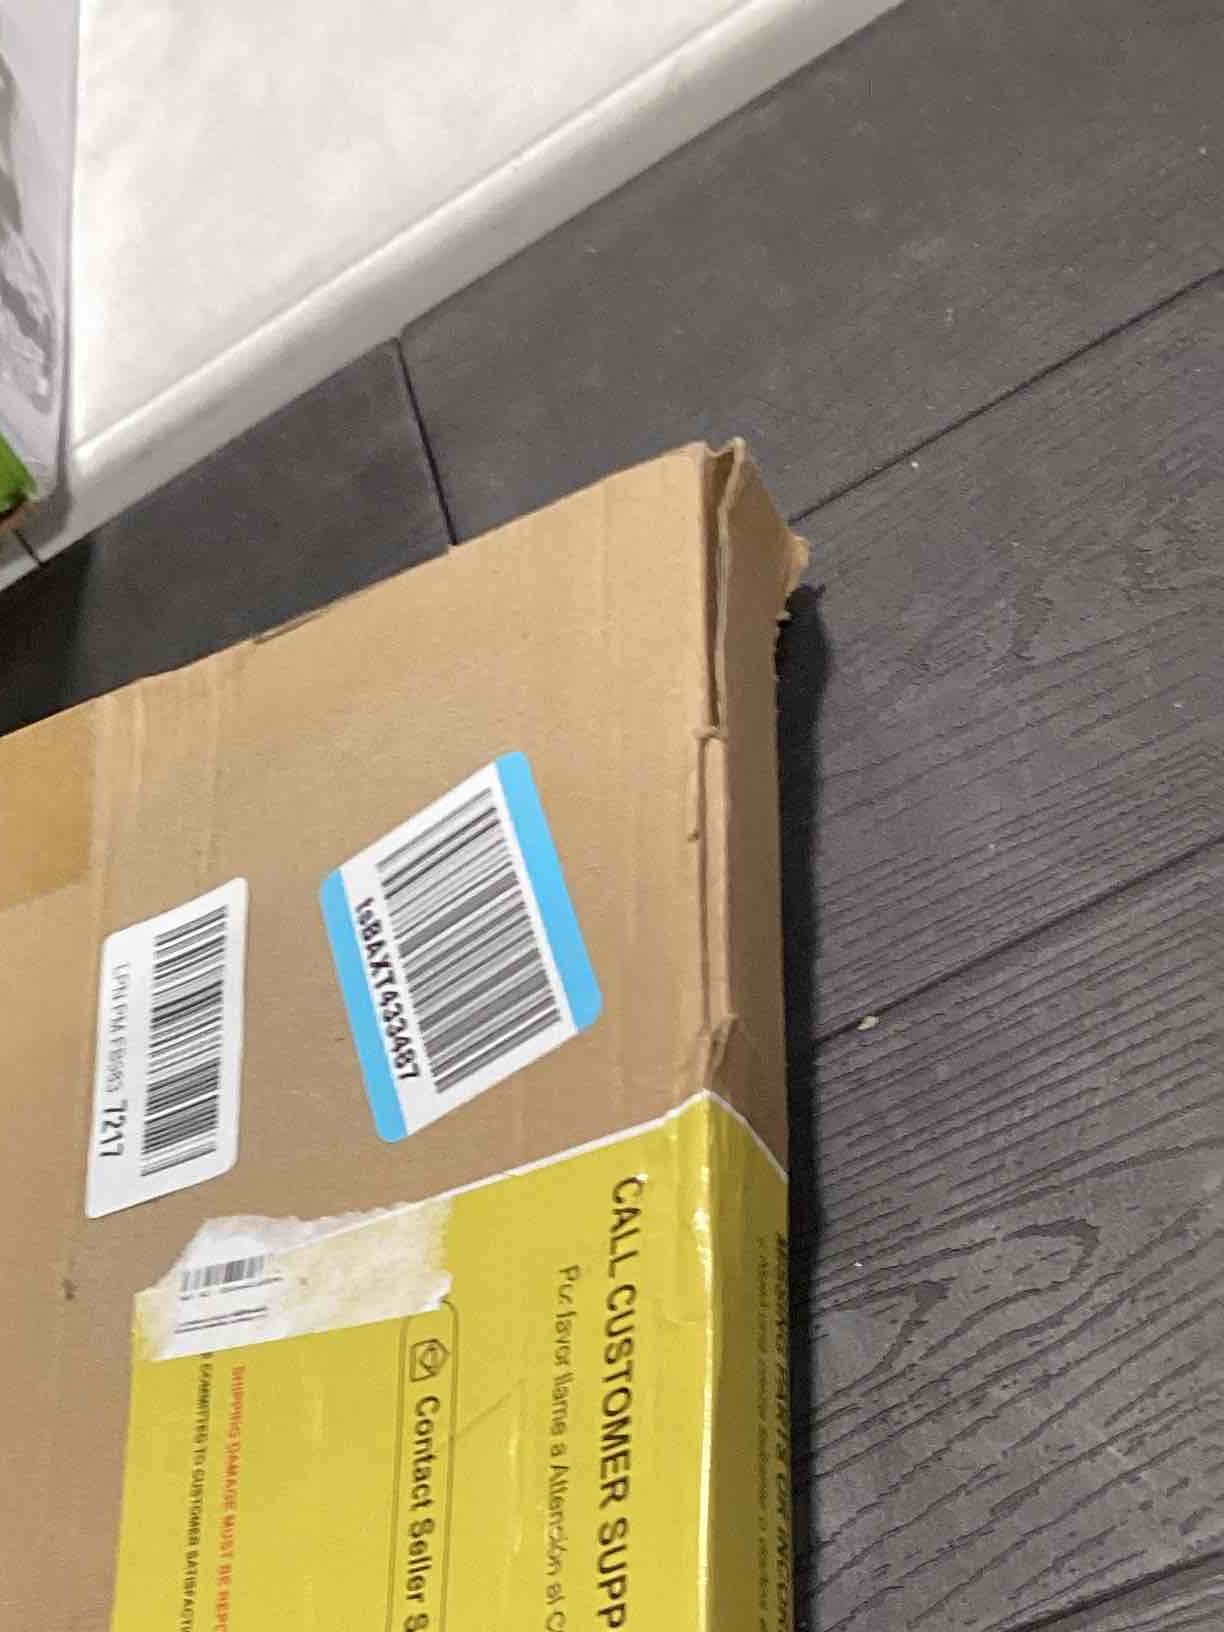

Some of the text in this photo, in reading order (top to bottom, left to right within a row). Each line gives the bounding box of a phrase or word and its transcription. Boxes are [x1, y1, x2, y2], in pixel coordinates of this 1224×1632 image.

[99, 1099, 128, 1157] 7217
[607, 1175, 643, 1281] CALL
[598, 1283, 637, 1510] CUSTOMER
[192, 1447, 207, 1465] TO
[408, 1395, 441, 1512] Contact
[187, 1468, 206, 1546] CUSTOMER
[219, 1514, 236, 1558] MUST
[405, 1517, 436, 1603] Seller
